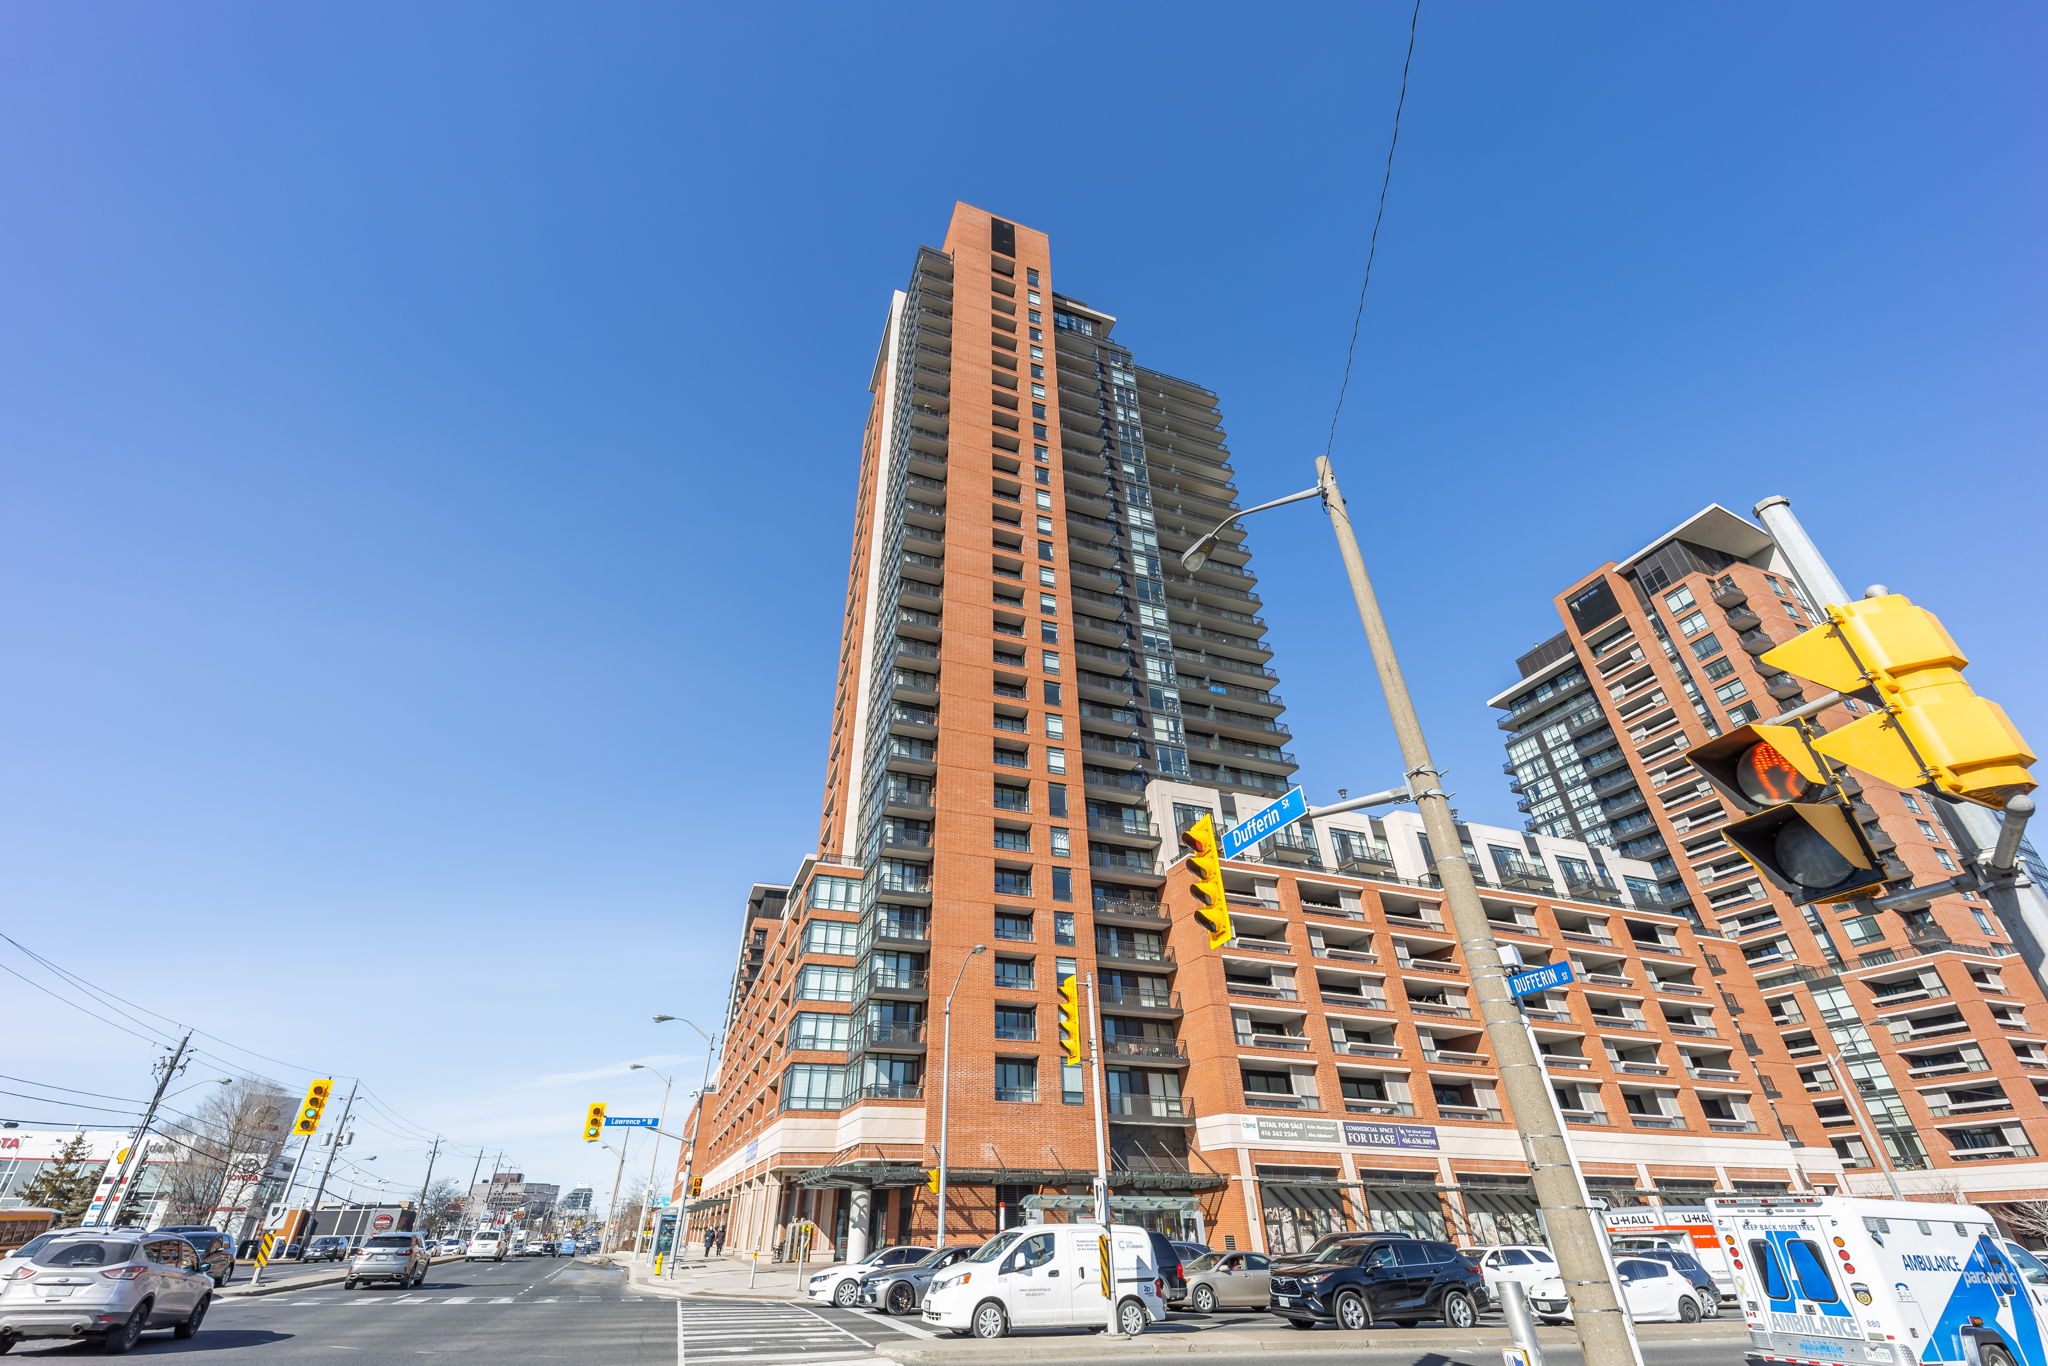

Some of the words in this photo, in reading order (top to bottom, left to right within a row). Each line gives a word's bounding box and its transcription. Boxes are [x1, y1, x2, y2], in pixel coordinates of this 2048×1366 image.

[1232, 808, 1280, 847] Dufferin
[1281, 798, 1290, 809] St
[1513, 968, 1559, 993] DUFFERIN
[1561, 971, 1569, 981] ST
[1290, 1122, 1304, 1130] SALE
[1345, 1125, 1378, 1133] COMMERCIAL
[1347, 1132, 1367, 1143] FOR
[1368, 1133, 1397, 1145] LEASE
[1788, 1224, 1816, 1232] METRES
[1901, 1254, 1963, 1272] AMBULANCE
[1963, 1262, 2018, 1288] paramedic
[1771, 1313, 1861, 1338] AMBULANCE
[1866, 1319, 1881, 1328] 880
